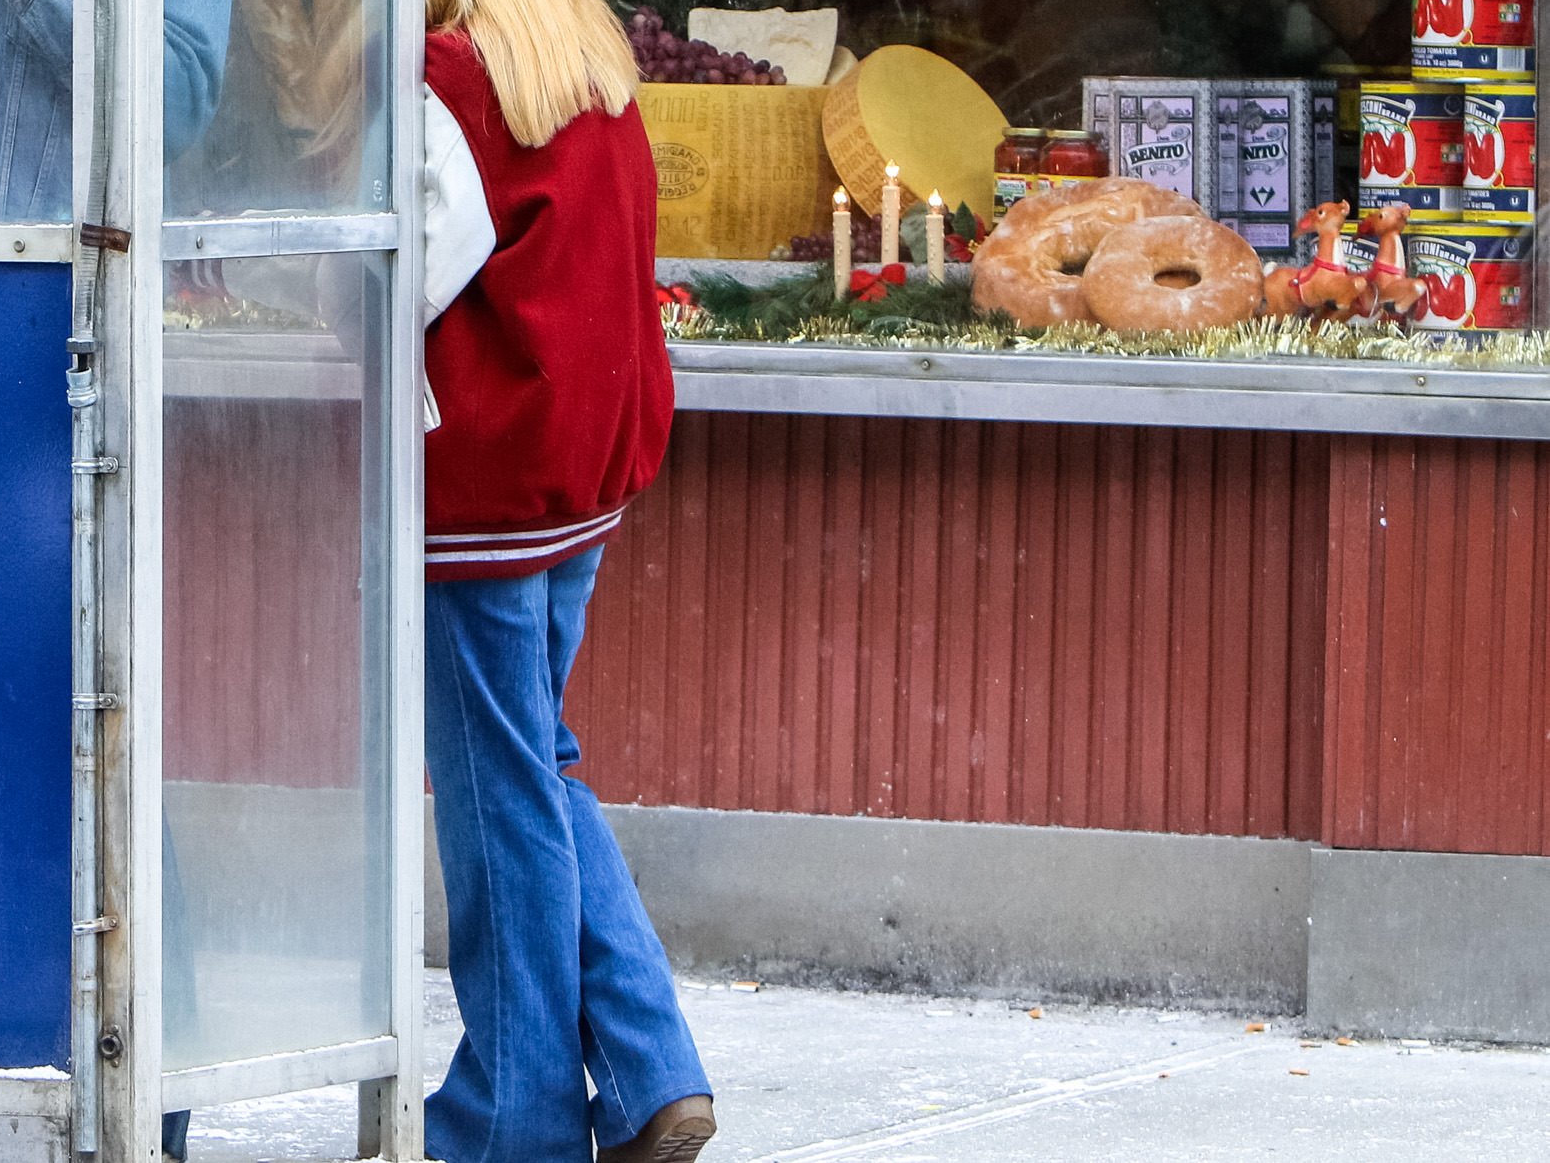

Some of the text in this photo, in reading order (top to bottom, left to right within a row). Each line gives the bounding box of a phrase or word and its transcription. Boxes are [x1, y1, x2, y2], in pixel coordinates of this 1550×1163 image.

[1381, 108, 1406, 124] BRAND
[1129, 143, 1185, 166] BENITO
[1242, 144, 1281, 160] NITO
[1352, 248, 1375, 262] BRAN
[1439, 249, 1466, 266] BRAND
